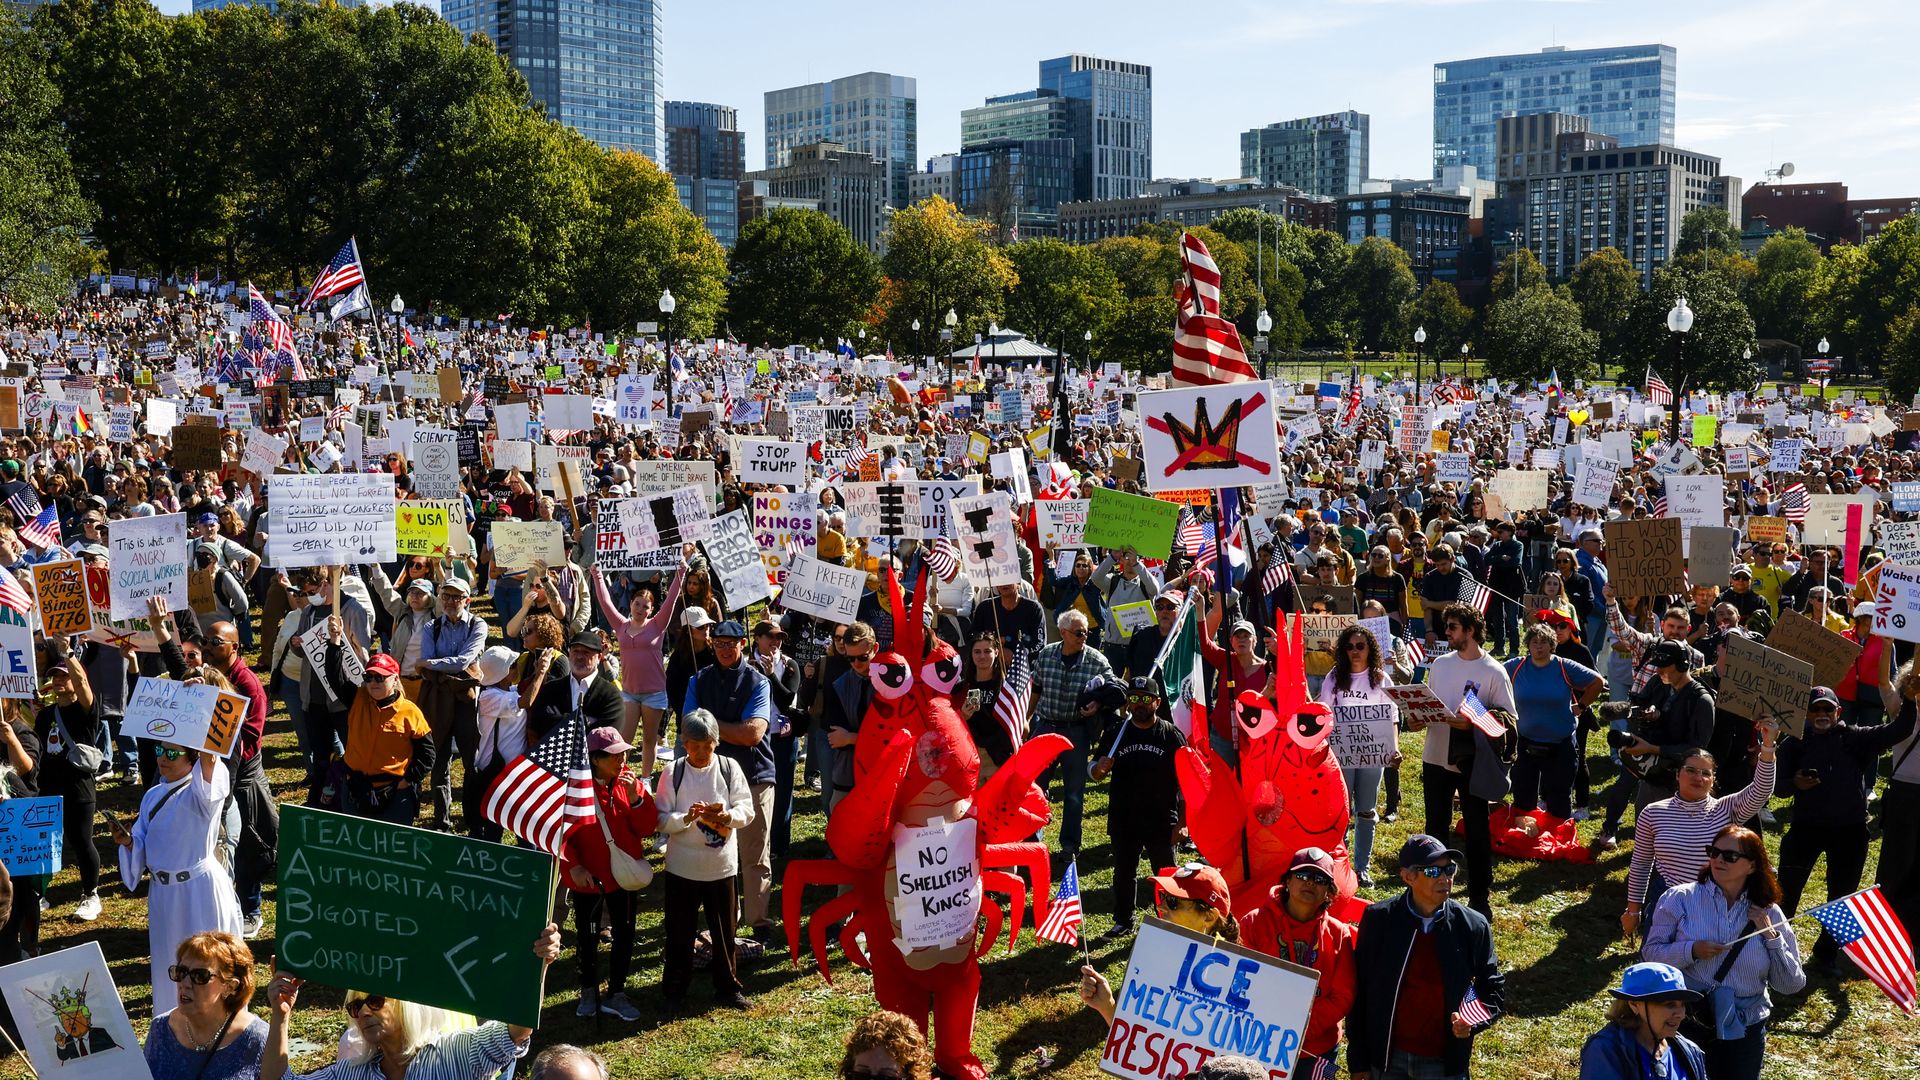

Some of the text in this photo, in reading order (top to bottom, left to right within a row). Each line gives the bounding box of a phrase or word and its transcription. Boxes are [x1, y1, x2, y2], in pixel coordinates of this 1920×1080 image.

[621, 406, 647, 420] USA
[807, 409, 824, 418] ONLY
[413, 431, 455, 443] SCIENCE
[1774, 440, 1800, 449] BOSTON
[556, 447, 590, 457] TYRANNY
[757, 446, 790, 458] STOP
[656, 463, 690, 472] AMERICA
[751, 461, 797, 473] TRUMP
[1442, 461, 1467, 469] RESPECT
[273, 476, 359, 487] WE THE PEOPLE
[640, 472, 708, 482] HOME OF THE BRAVE
[1586, 468, 1614, 482] Donald
[288, 486, 390, 500] WILL NOT FORGET
[847, 487, 866, 500] NO
[919, 487, 967, 502] FOX
[270, 507, 283, 515] THE
[288, 504, 328, 515] COWARDS
[330, 507, 339, 515] IN
[343, 503, 394, 515] CONGRESS
[757, 498, 780, 510] NO
[934, 504, 946, 513] IS
[1046, 502, 1083, 512] WHERE
[1141, 503, 1176, 517] LEGAL
[417, 513, 443, 526] USA
[756, 516, 811, 530] KINGS
[286, 520, 382, 534] WHO DID NOT
[704, 515, 744, 540] EMO-
[1615, 521, 1677, 539] I WISH
[1887, 524, 1911, 532] DOES
[1253, 528, 1269, 543] NO
[1888, 532, 1906, 540] ASS
[115, 537, 135, 551] This
[137, 538, 145, 548] is
[148, 536, 164, 546] what
[292, 539, 335, 552] SPEAK
[407, 539, 427, 549] HERE
[708, 530, 750, 560] CRACY
[1608, 538, 1677, 558] HIS DAD
[1890, 542, 1916, 550] MAKE
[130, 550, 167, 567] ANGRY
[617, 558, 655, 568] BRENNER
[715, 547, 760, 575] NEEDS
[39, 565, 64, 583] No
[793, 558, 858, 590] I PREFER
[1617, 558, 1672, 577] HUGGED
[119, 567, 152, 588] SOCIAL
[154, 562, 185, 580] WORKER
[1882, 568, 1913, 583] Wake
[39, 582, 84, 598] Kings
[153, 582, 172, 595] like!
[1609, 577, 1682, 597] HIM MORE
[42, 595, 84, 613] Since
[787, 582, 856, 613] CRUSHED ICE
[1876, 583, 1896, 629] SAVE
[48, 610, 86, 630] 1776
[1767, 659, 1786, 674] MAD
[1786, 670, 1797, 678] AS
[0, 676, 36, 693] AMILIES
[142, 680, 206, 700] MAY the
[1722, 664, 1810, 711] I LOVE THIS PLACE
[136, 695, 180, 709] FORCE
[1343, 690, 1368, 700] GAZA
[1334, 705, 1391, 722] PROTEST?
[207, 698, 233, 748] 1776
[1350, 724, 1369, 734] IT'S
[1346, 734, 1373, 743] THAN
[1119, 744, 1165, 756] ANTIFASCIST
[1340, 744, 1385, 754] A FAMILY
[1360, 753, 1391, 766] ATTIC
[300, 815, 432, 865] TEACHER
[16, 851, 62, 864] BALANCES
[918, 847, 948, 868] NO
[284, 848, 523, 919] AUTHORITARIAN
[899, 863, 973, 895] SHELLFISH
[922, 889, 971, 917] KINGS
[285, 888, 419, 936] BIGOTED
[282, 931, 408, 982] CORRUPT
[1176, 942, 1260, 1010] ICE
[1209, 1010, 1299, 1070] UNDER
